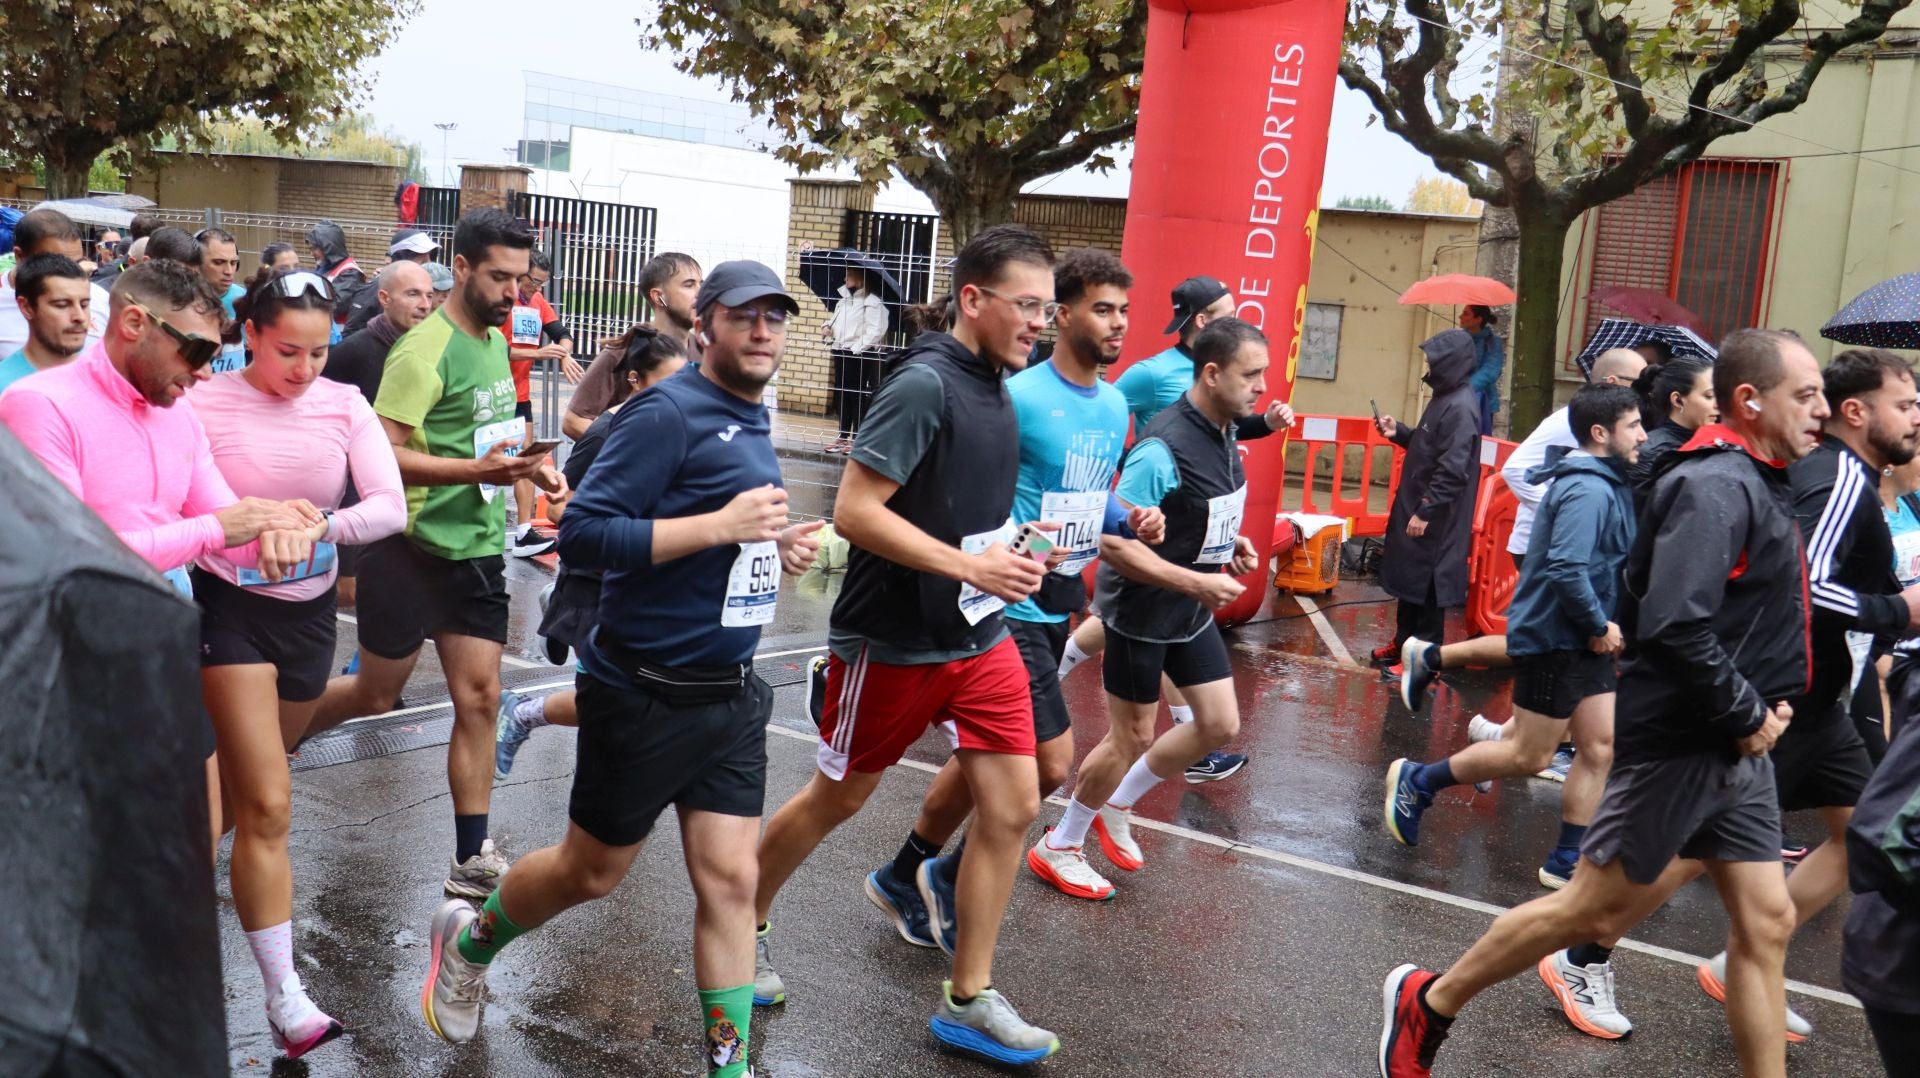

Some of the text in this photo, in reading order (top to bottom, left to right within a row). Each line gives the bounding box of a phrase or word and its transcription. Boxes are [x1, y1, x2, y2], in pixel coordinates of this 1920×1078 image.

[1235, 43, 1305, 331] DE DEPORTES
[521, 319, 537, 334] 593
[1057, 520, 1094, 550] 1044
[749, 553, 777, 594] 992
